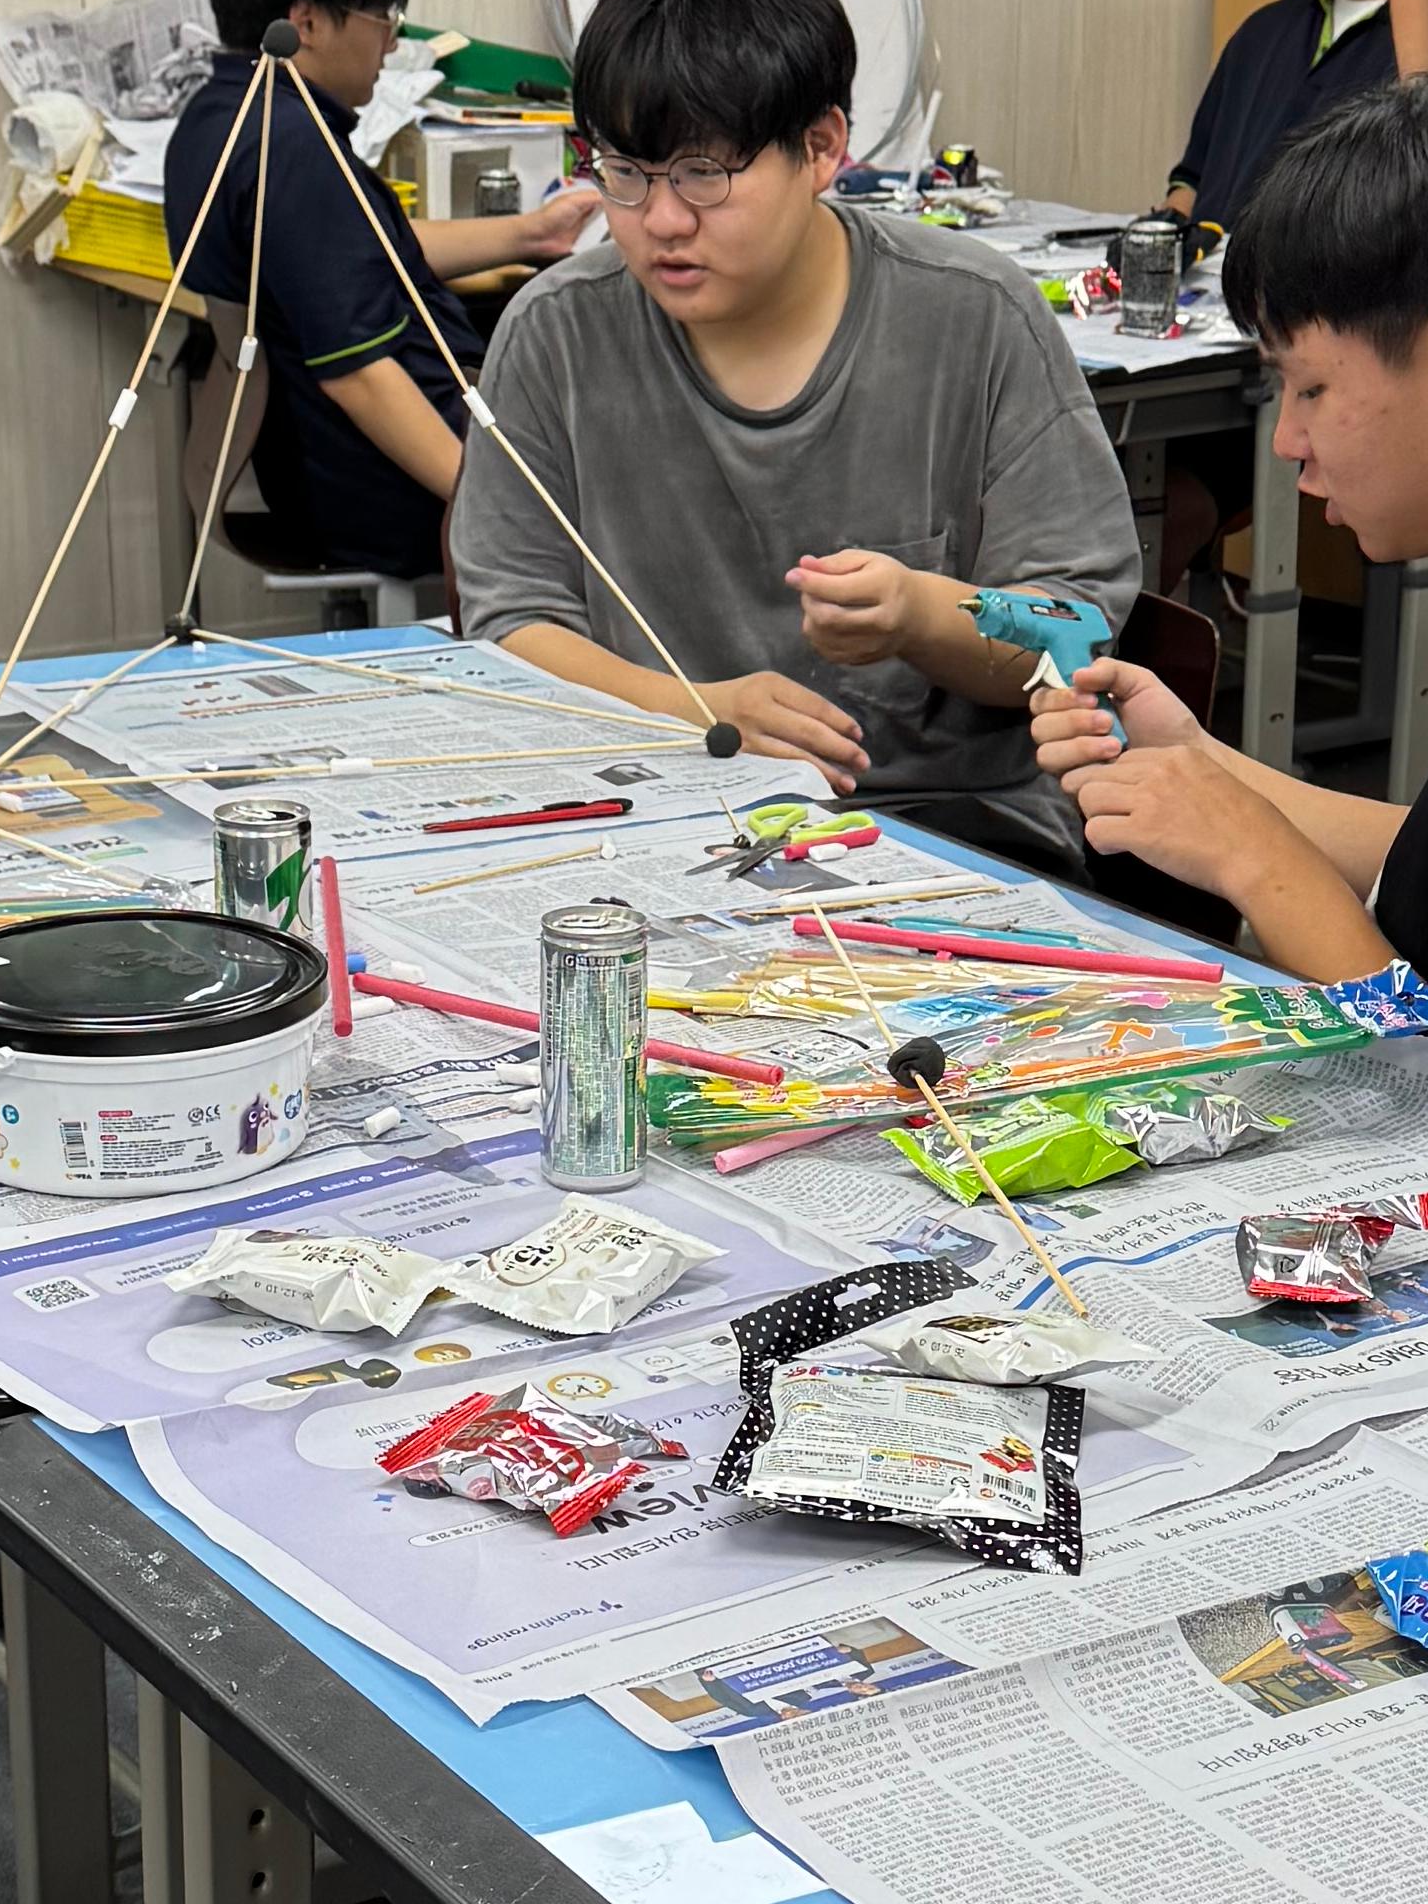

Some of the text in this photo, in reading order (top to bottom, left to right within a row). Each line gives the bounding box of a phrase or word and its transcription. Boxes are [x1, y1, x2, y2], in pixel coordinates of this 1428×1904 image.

[1258, 1417, 1280, 1434] 22
[467, 1604, 591, 1652] Techfin ratings
[1307, 1710, 1367, 1742] 아니고
